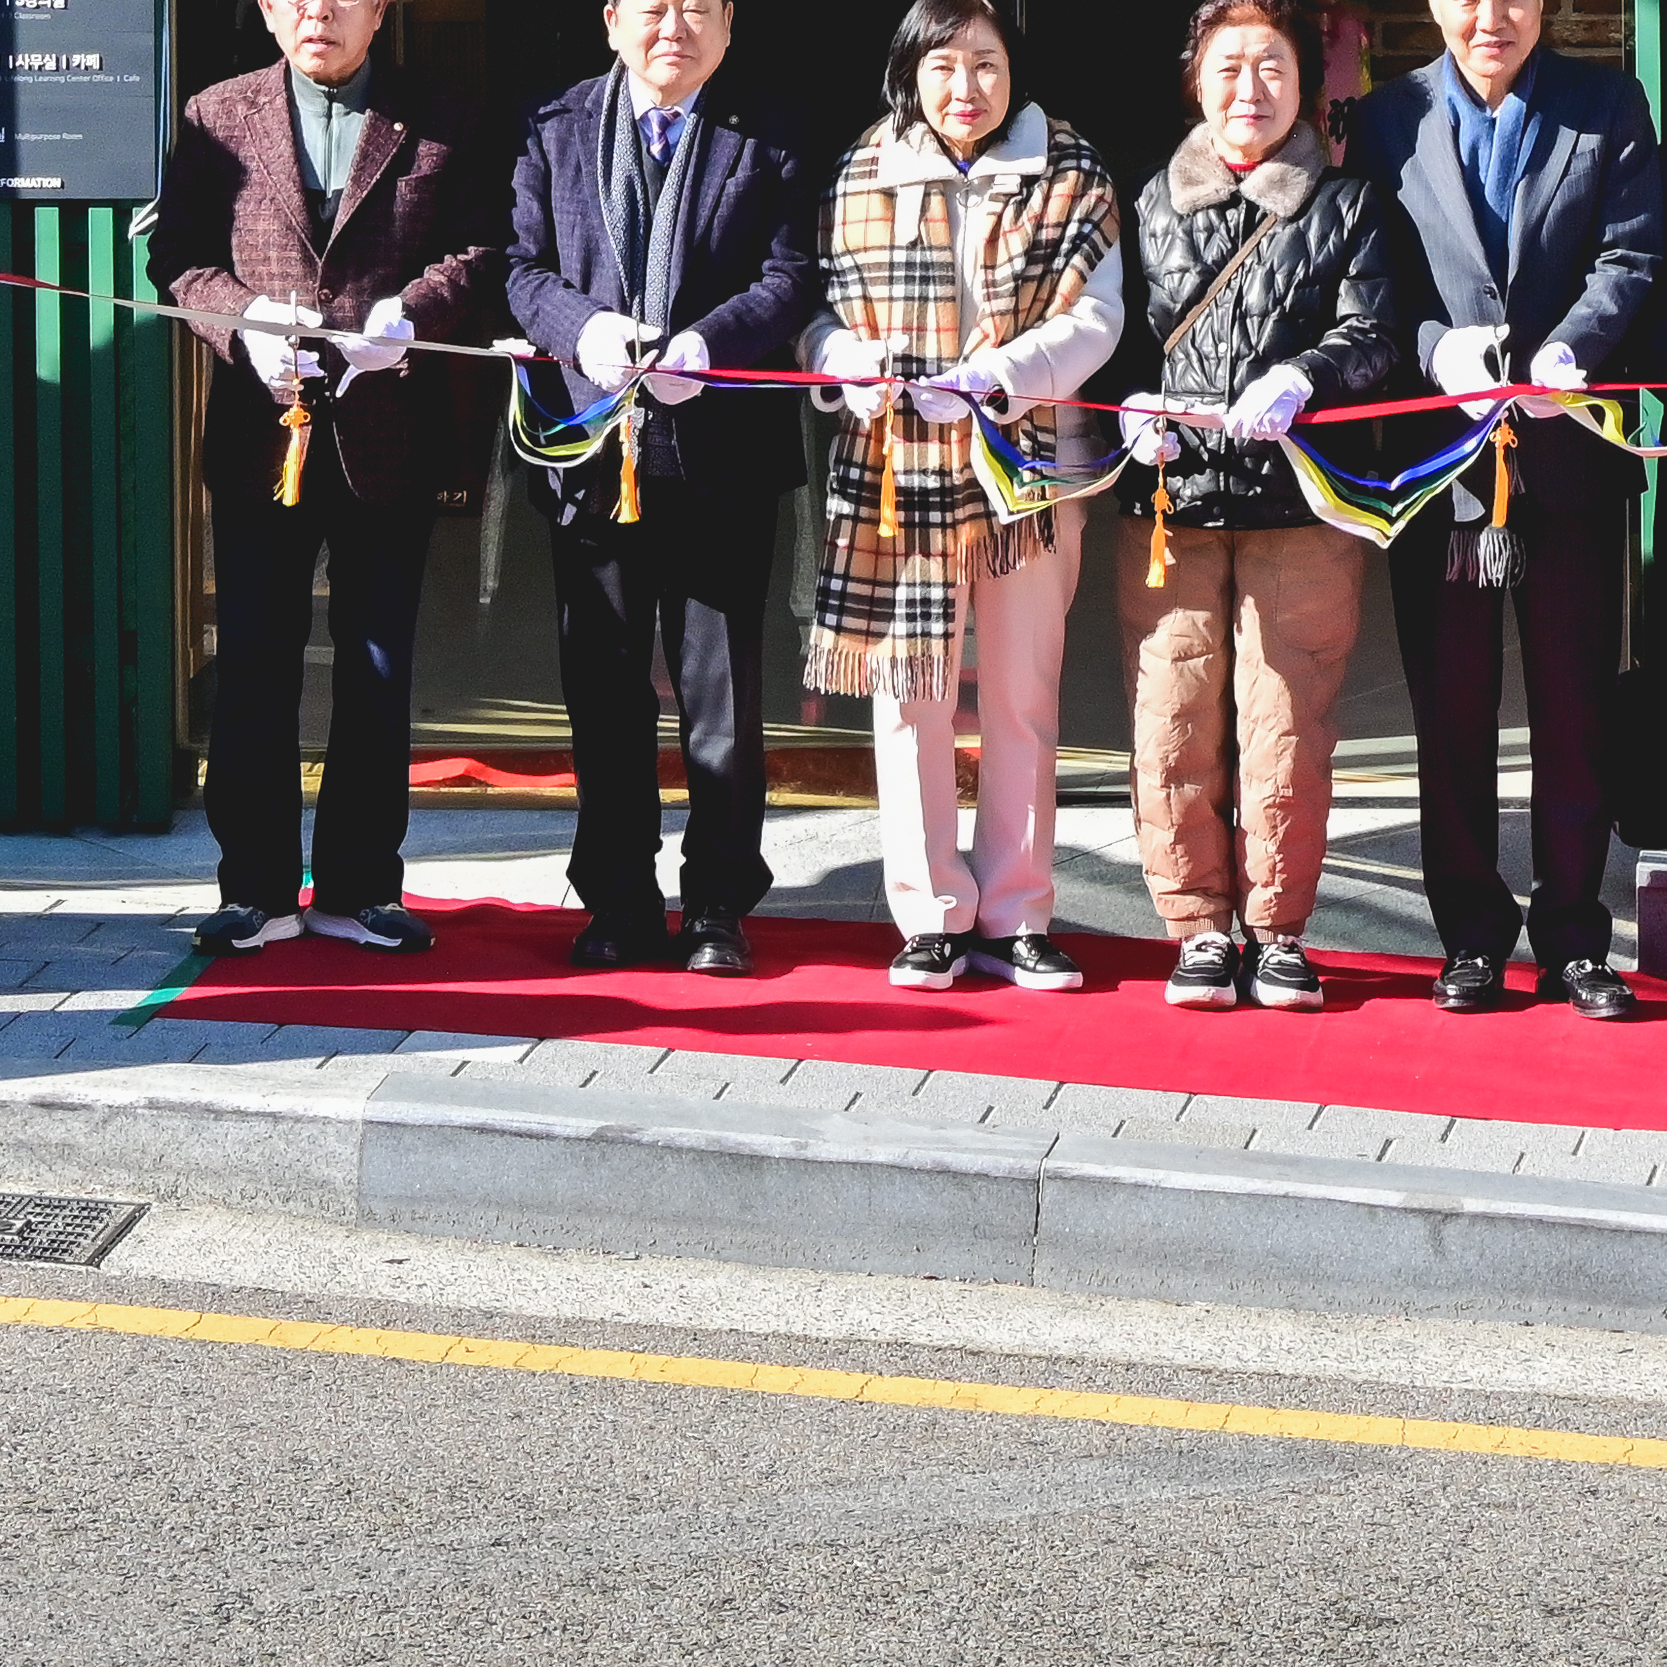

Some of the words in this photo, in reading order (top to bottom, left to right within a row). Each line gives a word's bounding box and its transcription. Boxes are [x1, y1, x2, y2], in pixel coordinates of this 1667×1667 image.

[16, 54, 56, 70] 사무실
[72, 54, 100, 69] 카페
[0, 178, 61, 188] FORMATION
